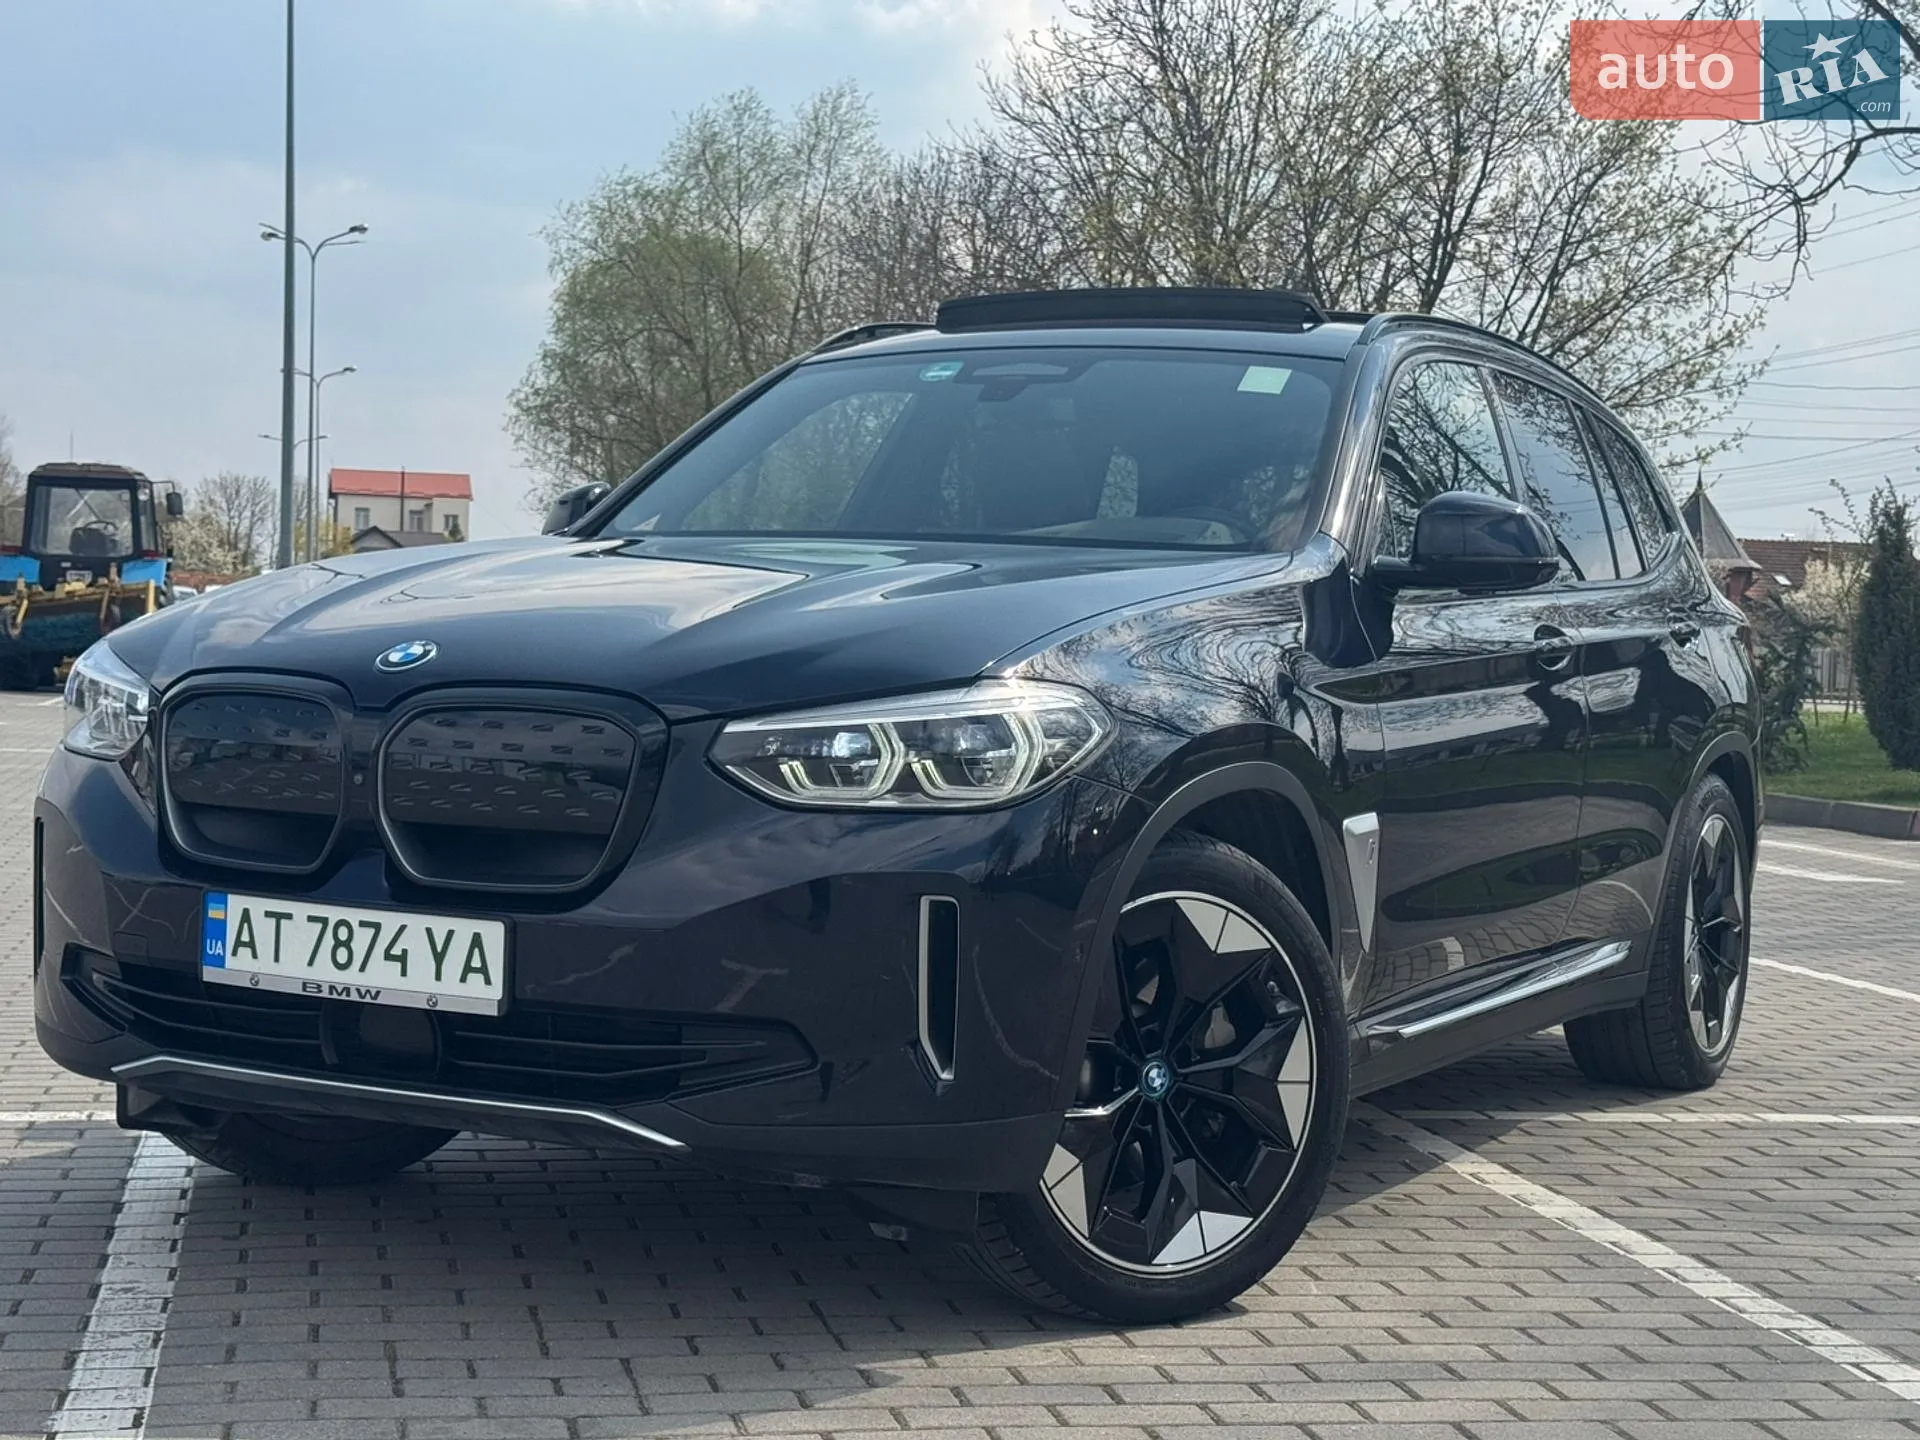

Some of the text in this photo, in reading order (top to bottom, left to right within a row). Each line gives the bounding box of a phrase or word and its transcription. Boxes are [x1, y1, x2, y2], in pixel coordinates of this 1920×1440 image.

[206, 939, 224, 957] UA
[231, 907, 492, 986] AT 7874 YA
[301, 981, 382, 1001] BMW
